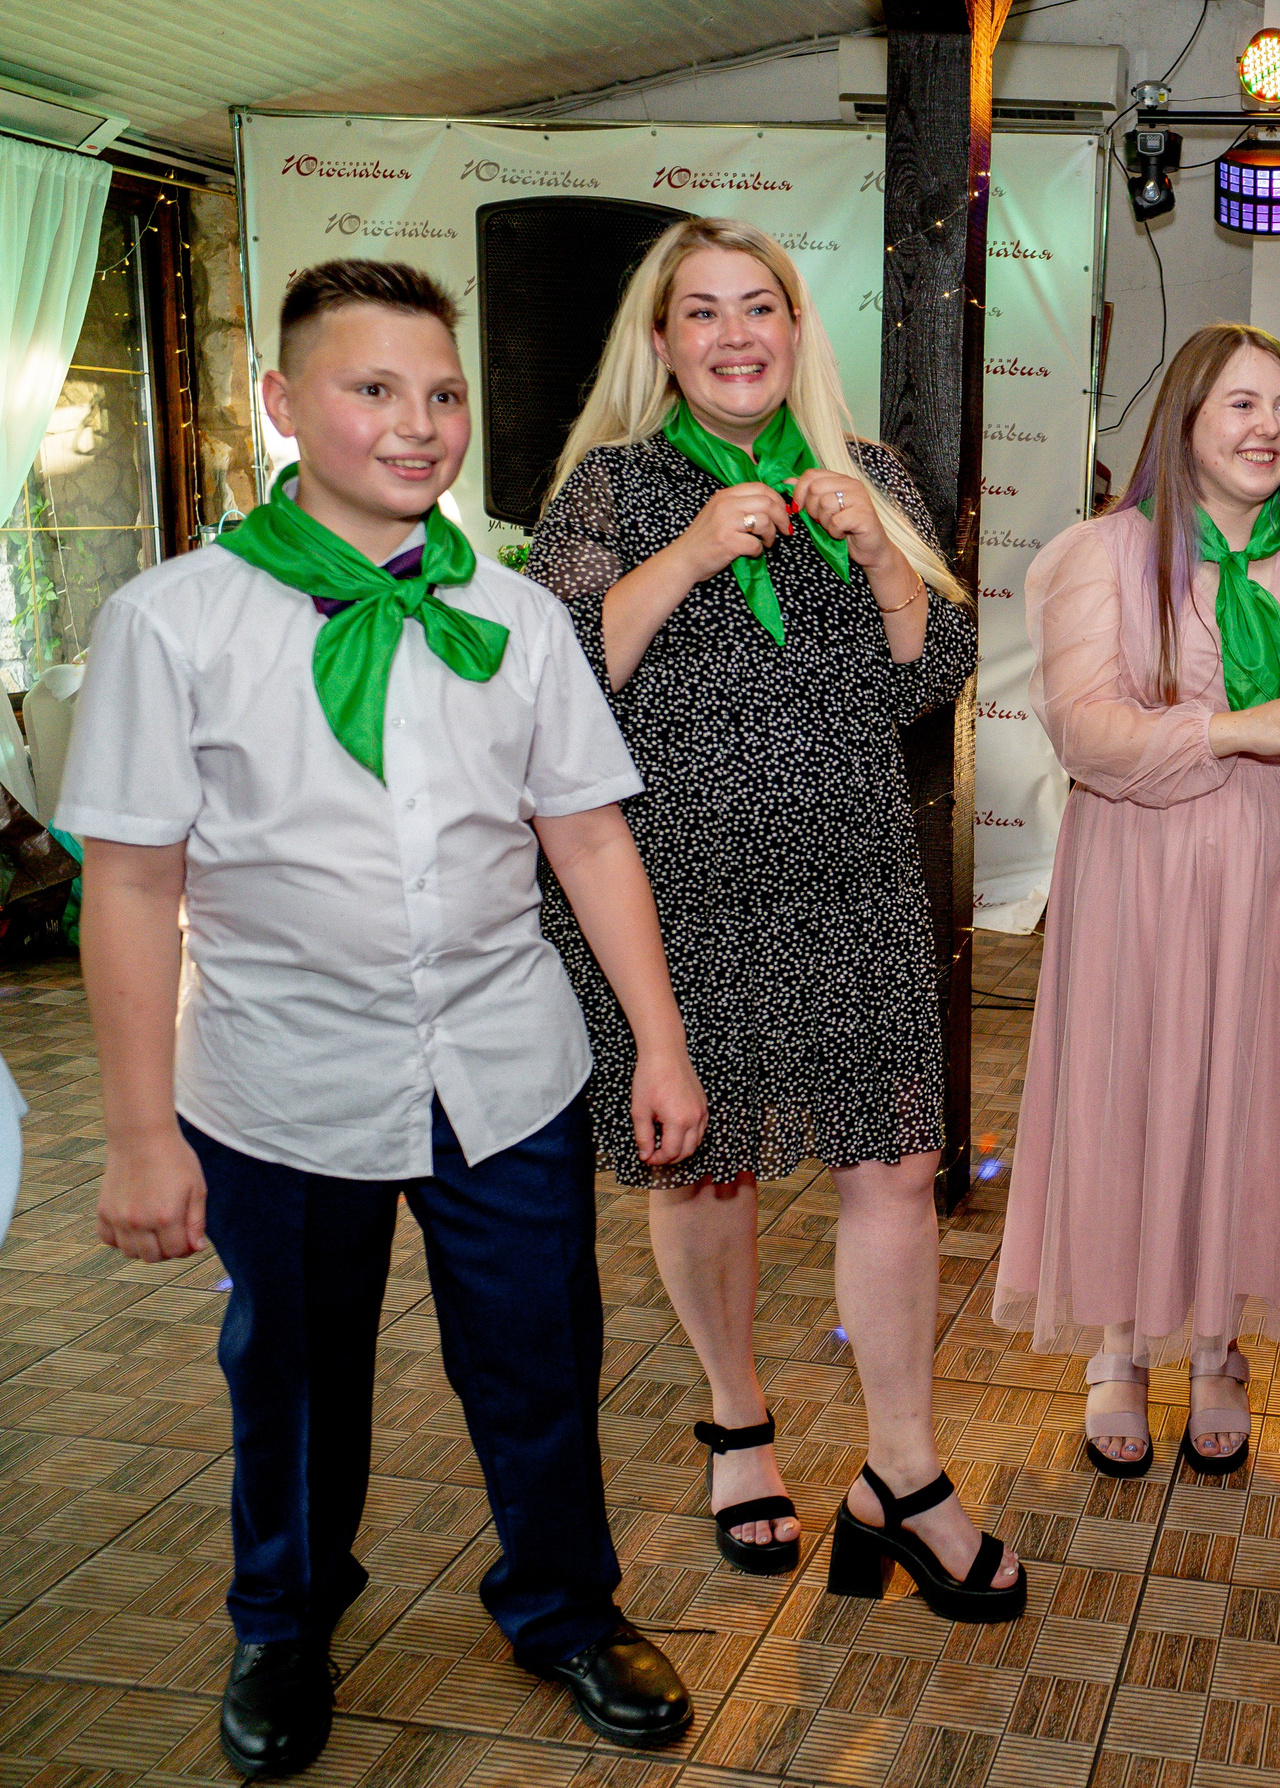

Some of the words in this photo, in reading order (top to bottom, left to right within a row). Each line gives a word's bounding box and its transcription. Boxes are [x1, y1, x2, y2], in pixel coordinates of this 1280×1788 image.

[281, 153, 412, 180] Югославия
[460, 158, 601, 189] Югославия
[652, 165, 793, 192] Югославия
[324, 212, 458, 240] Югославия
